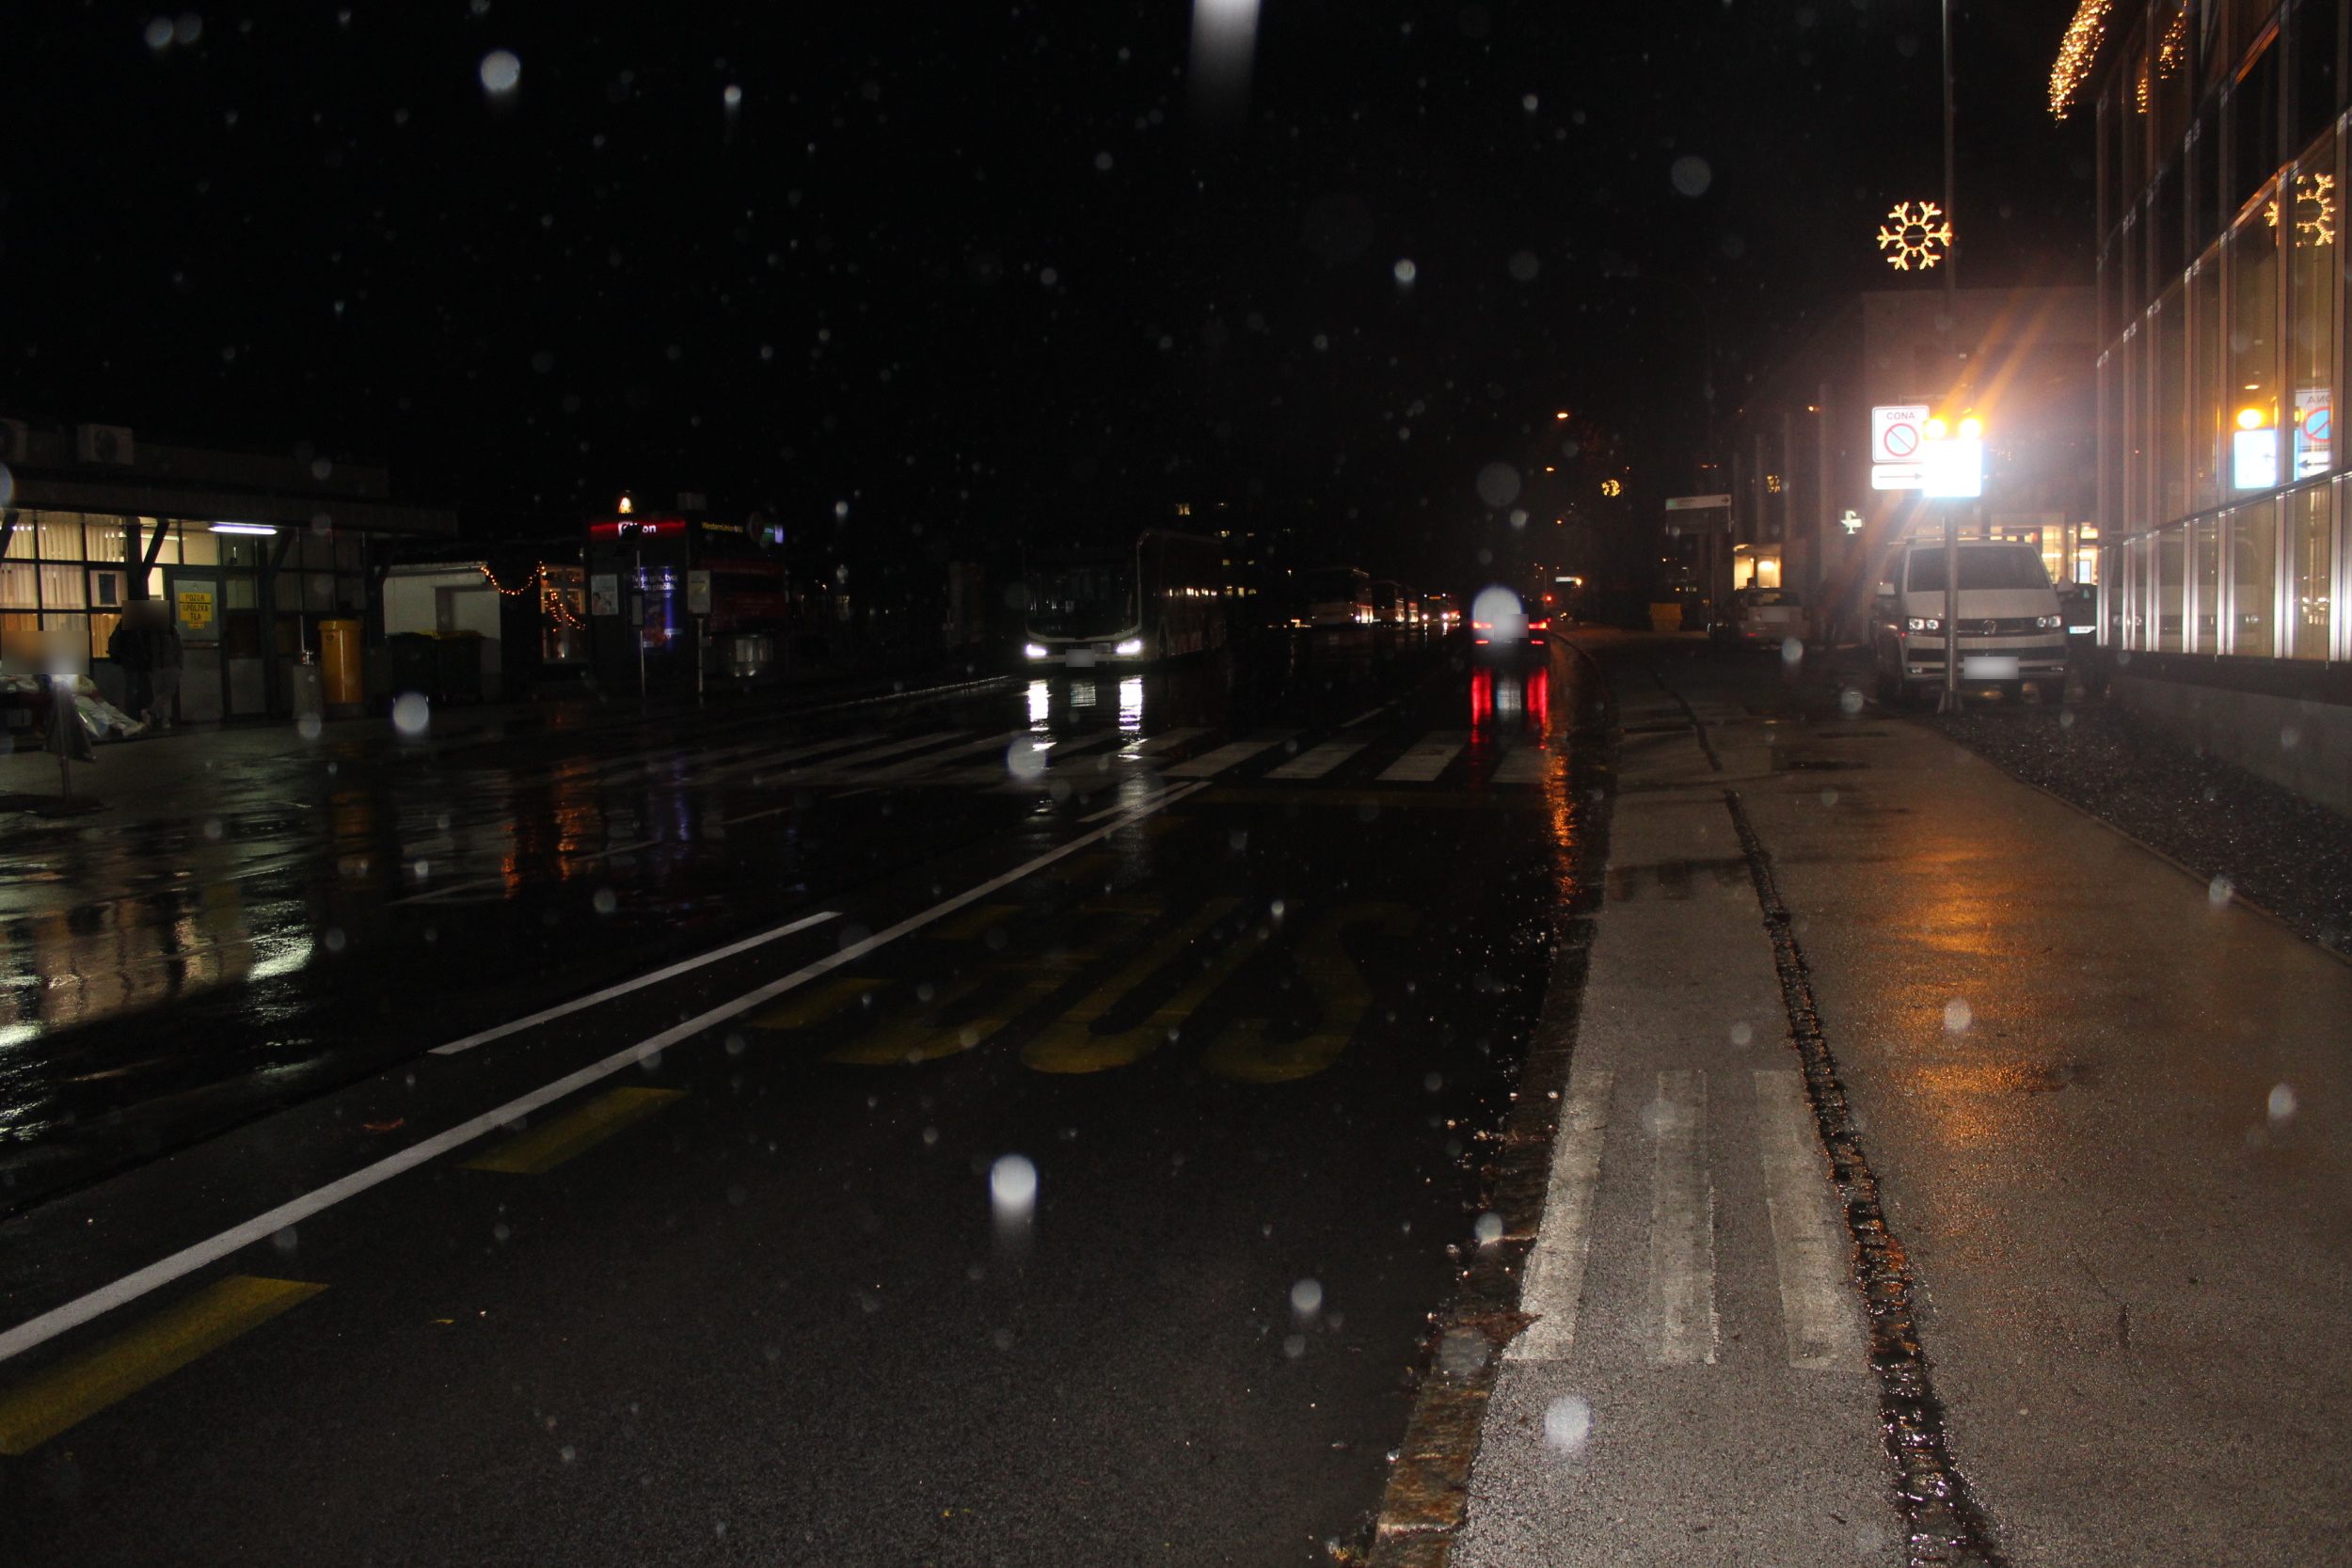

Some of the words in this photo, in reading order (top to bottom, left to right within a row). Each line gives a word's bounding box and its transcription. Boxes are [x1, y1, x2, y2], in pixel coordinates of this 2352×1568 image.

[1886, 411, 1915, 420] CONA
[185, 594, 205, 602] POZOR
[818, 894, 1424, 1086] BUS
